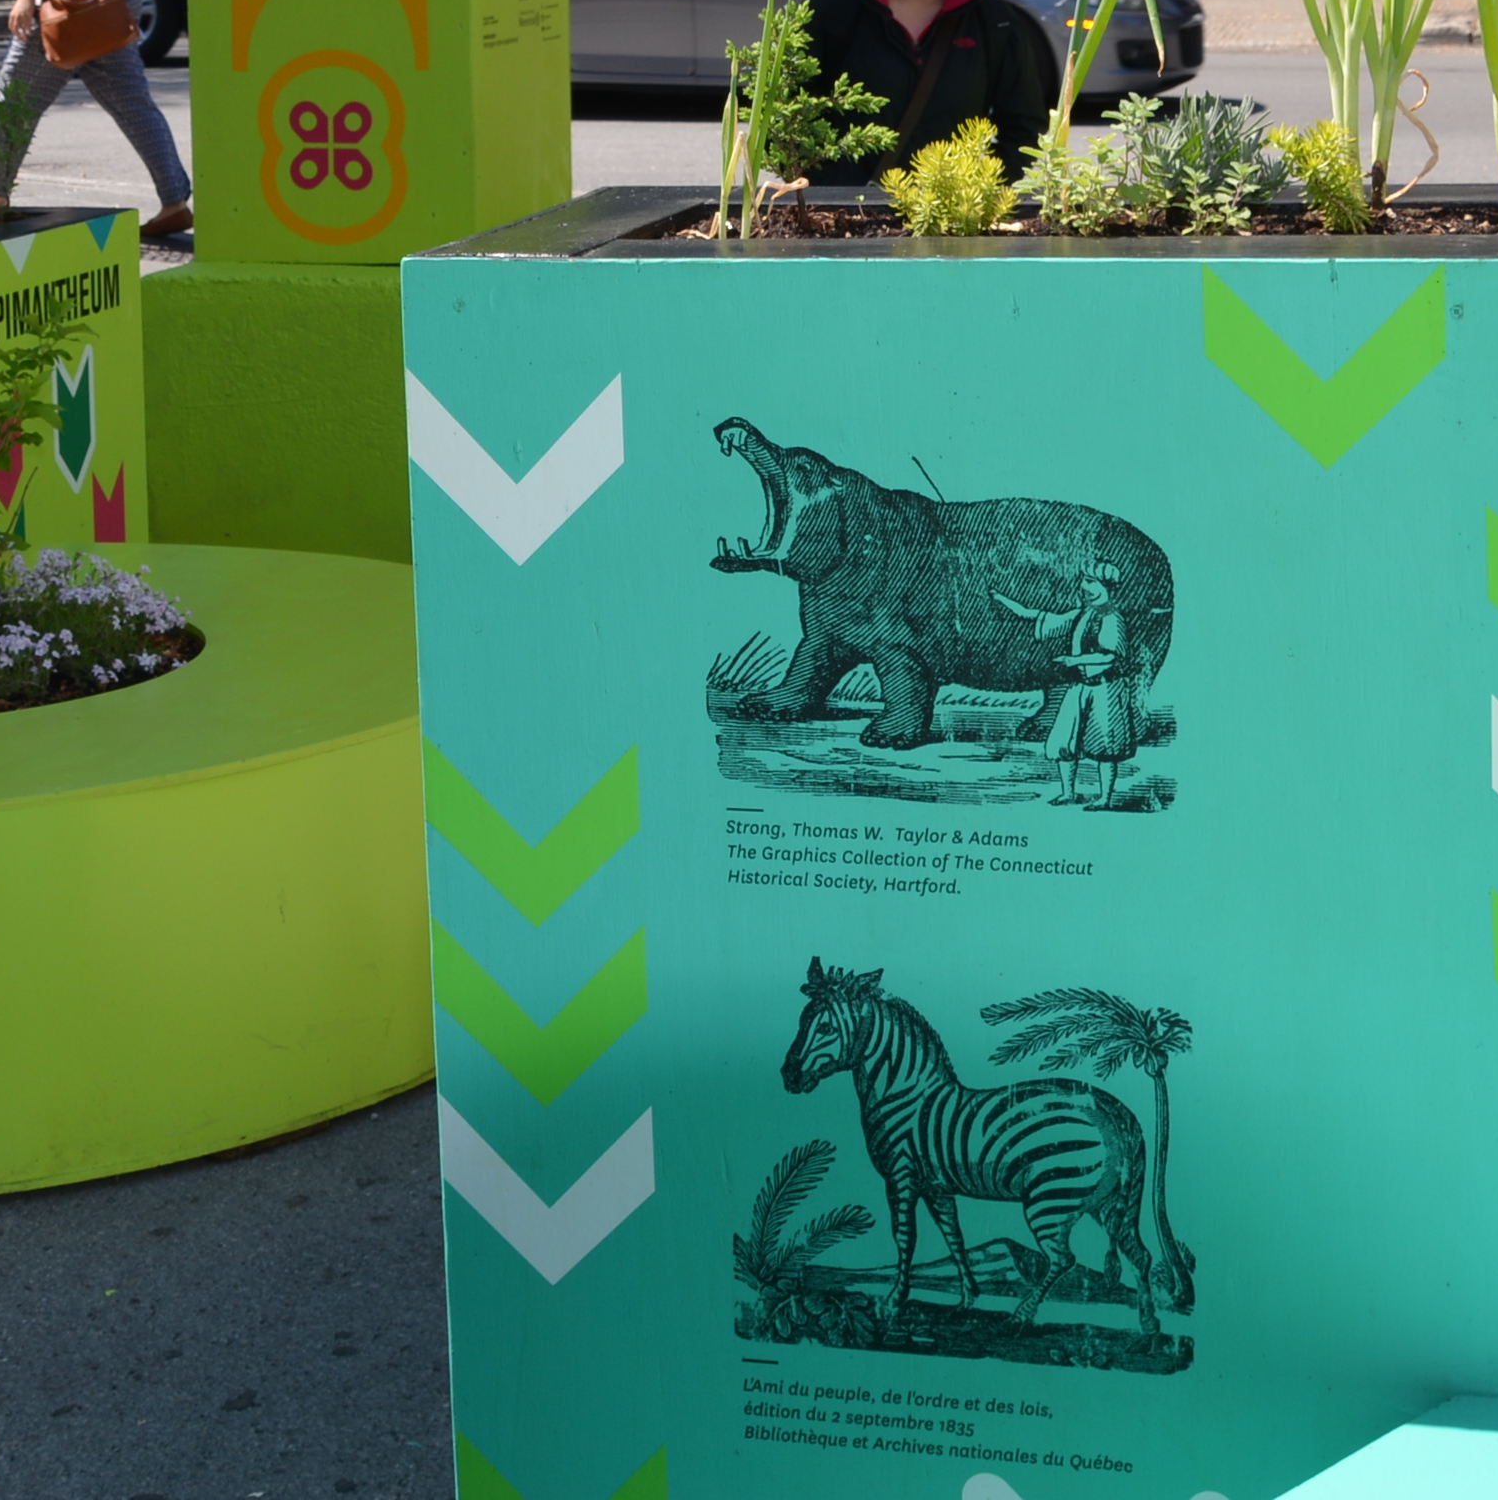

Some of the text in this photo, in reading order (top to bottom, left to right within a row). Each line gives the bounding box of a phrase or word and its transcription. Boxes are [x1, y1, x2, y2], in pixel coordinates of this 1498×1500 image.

[725, 818, 1029, 848] Strong, Thomas W. Taylor & Adams
[727, 843, 1094, 876] The Graphics Collection of The Connecticut
[727, 868, 962, 898] Historical Society, Hartford.
[742, 1376, 1054, 1420] L'Ami du peuple, de l'ordre et des lois,
[743, 1399, 975, 1438] édition du 2 septembre 1835
[744, 1424, 1134, 1474] Bibliothèque et Archives nationales du Québec
